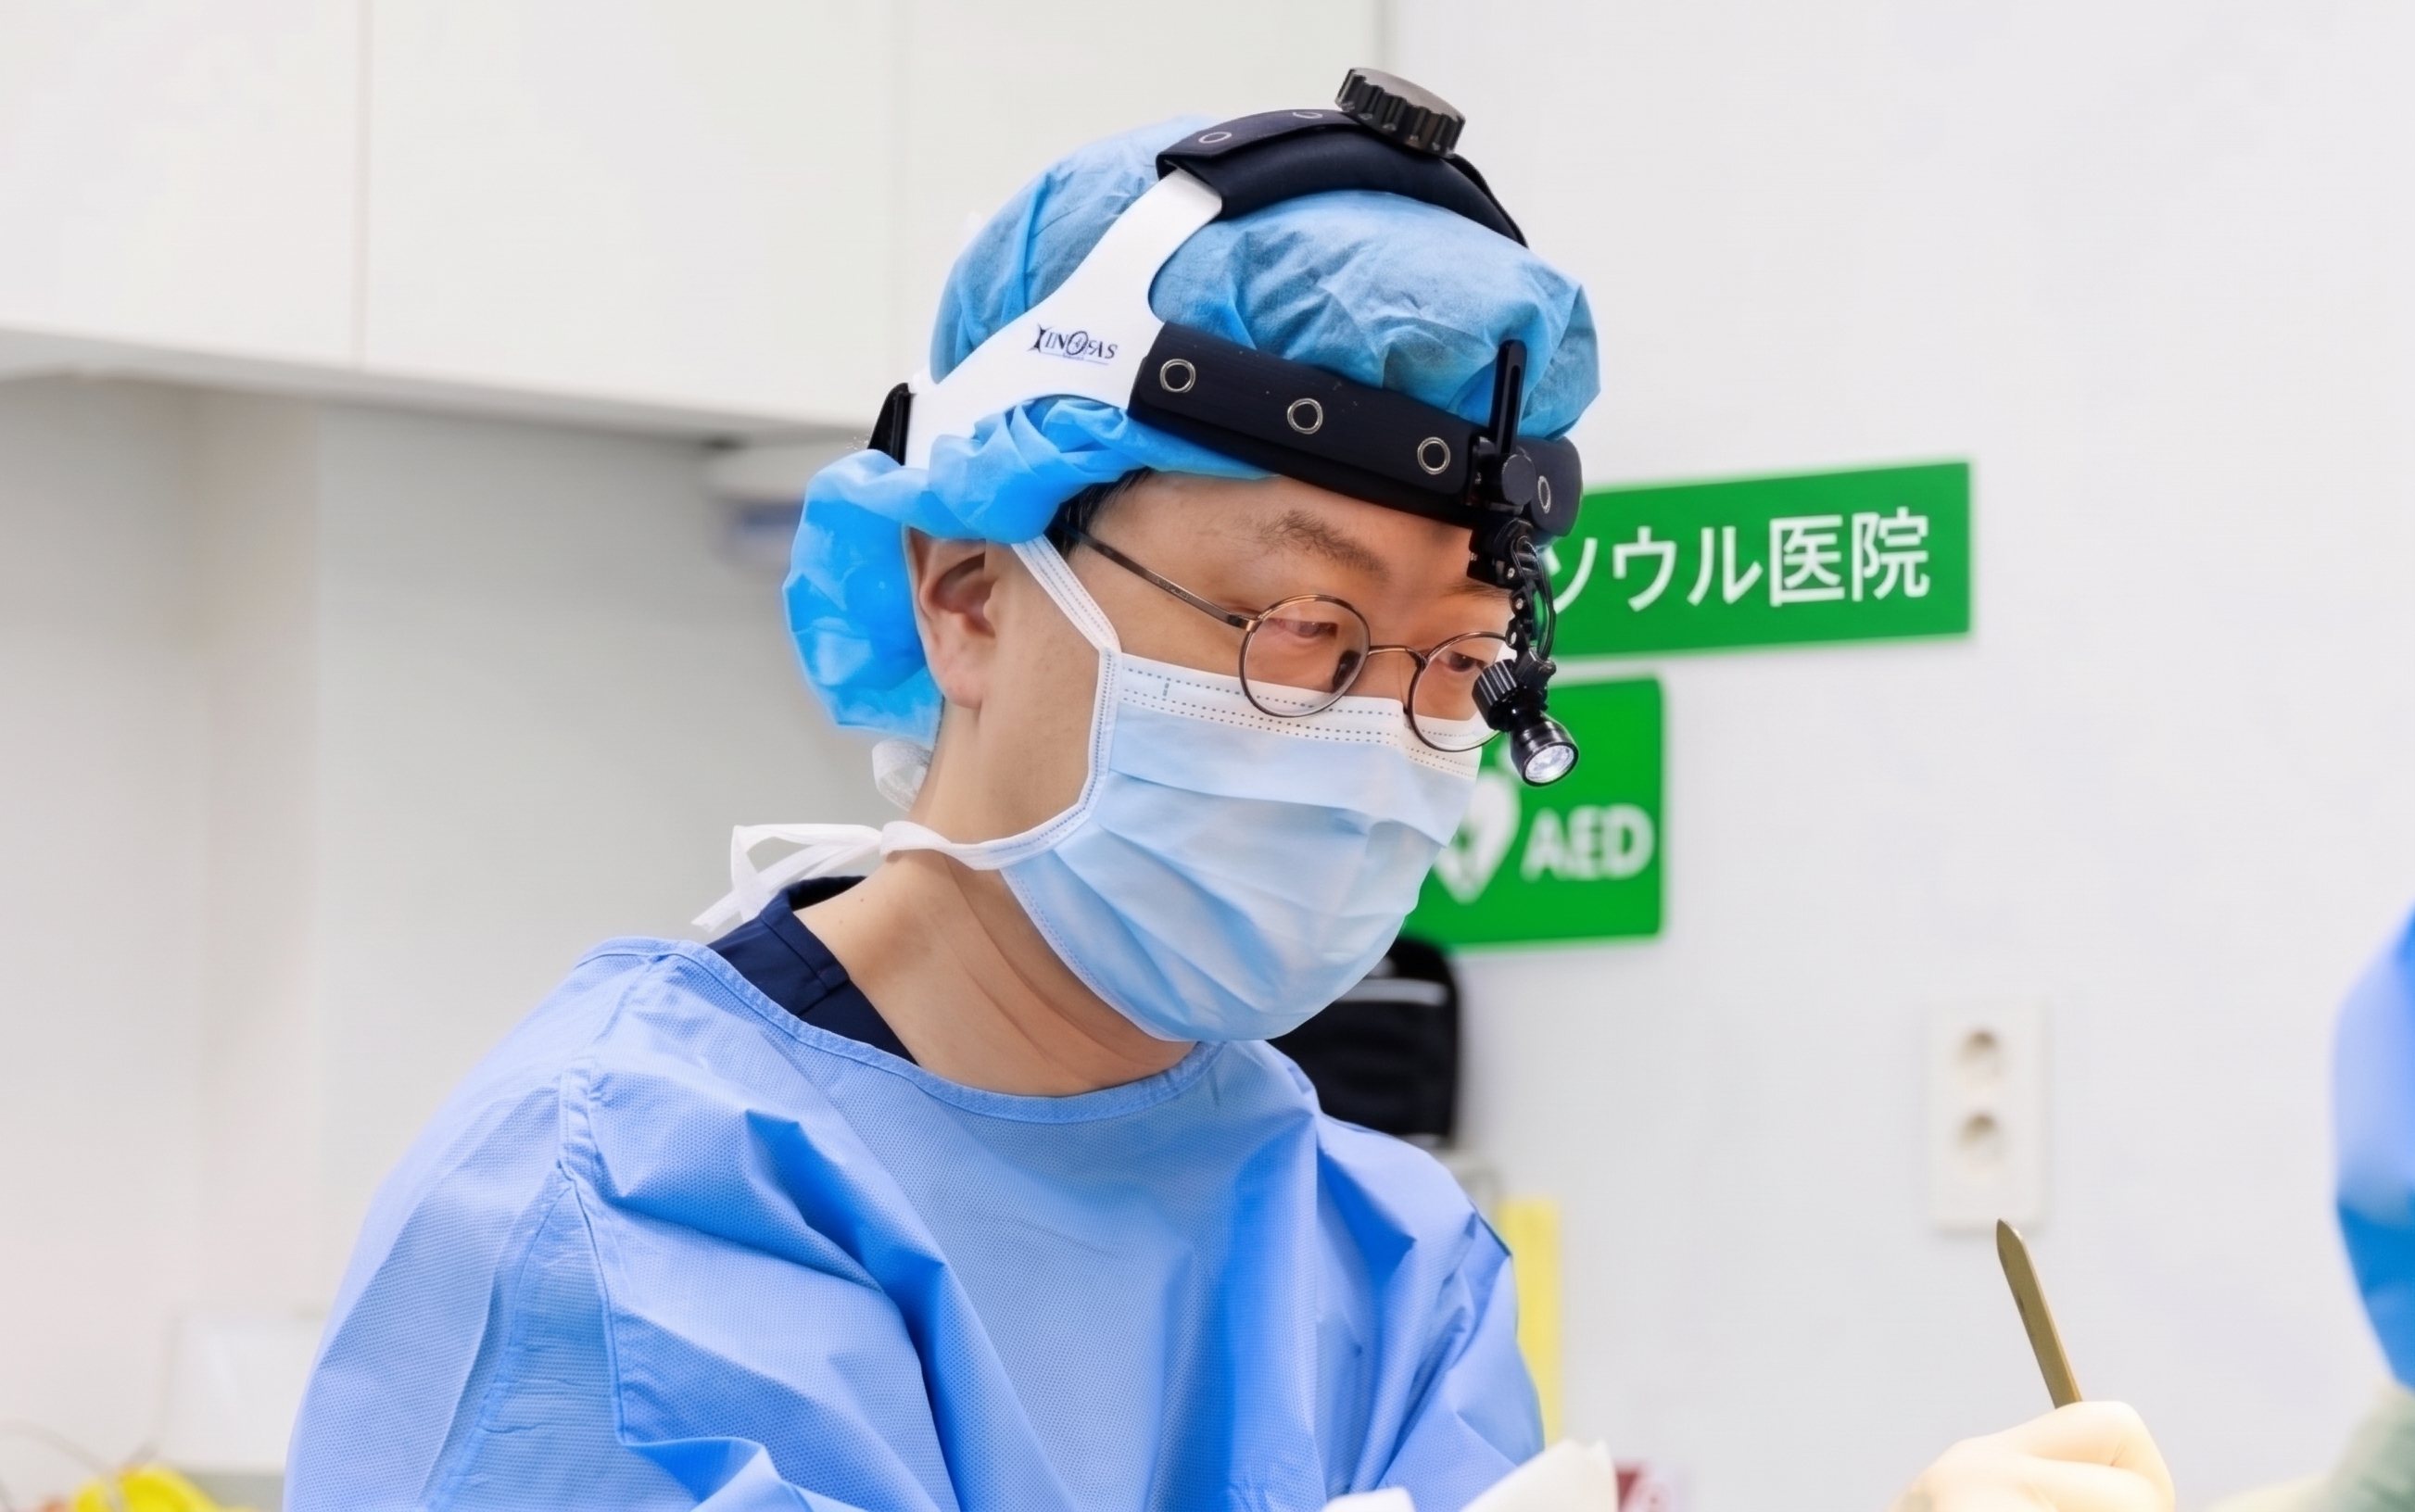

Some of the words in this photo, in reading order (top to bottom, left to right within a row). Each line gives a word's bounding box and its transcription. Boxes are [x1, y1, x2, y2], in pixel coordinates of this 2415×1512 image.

[1540, 507, 1930, 614] ソウル医院
[1520, 804, 1655, 882] AED
